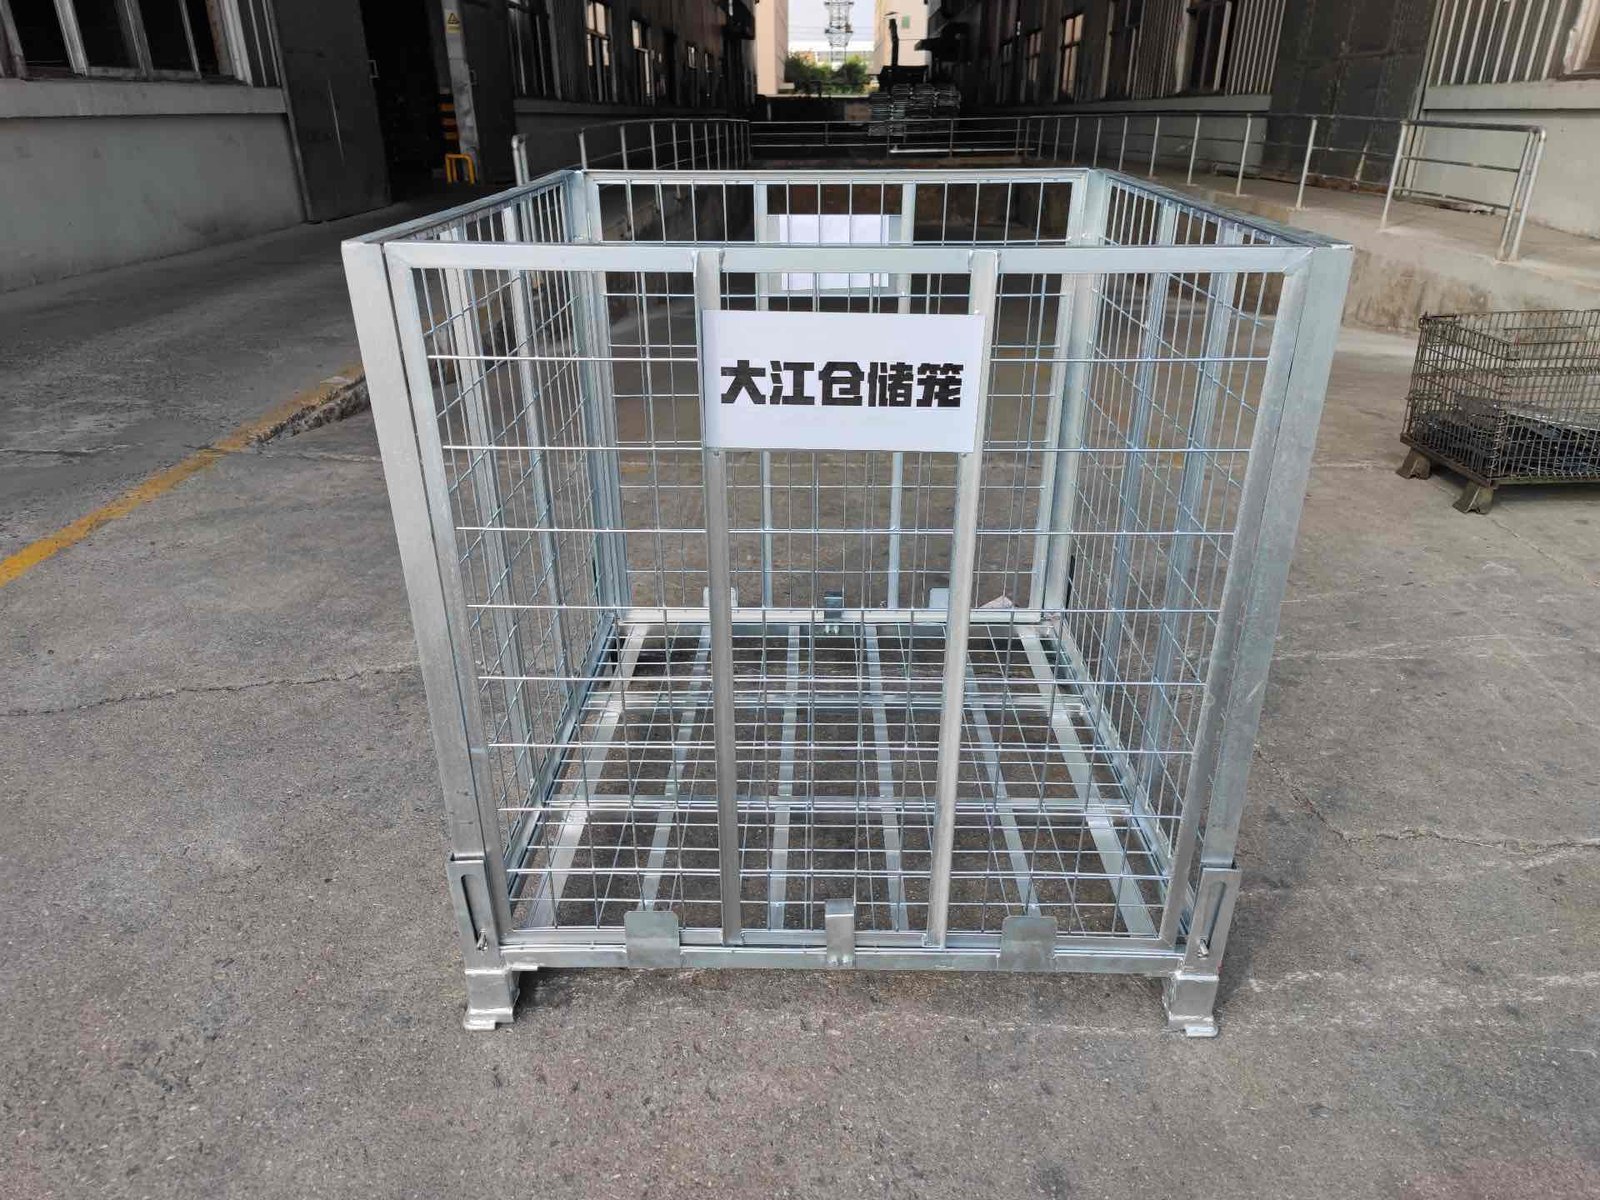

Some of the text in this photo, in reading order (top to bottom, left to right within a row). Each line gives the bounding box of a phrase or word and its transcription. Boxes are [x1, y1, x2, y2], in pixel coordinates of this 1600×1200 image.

[720, 359, 964, 408] 大江仓储笼
